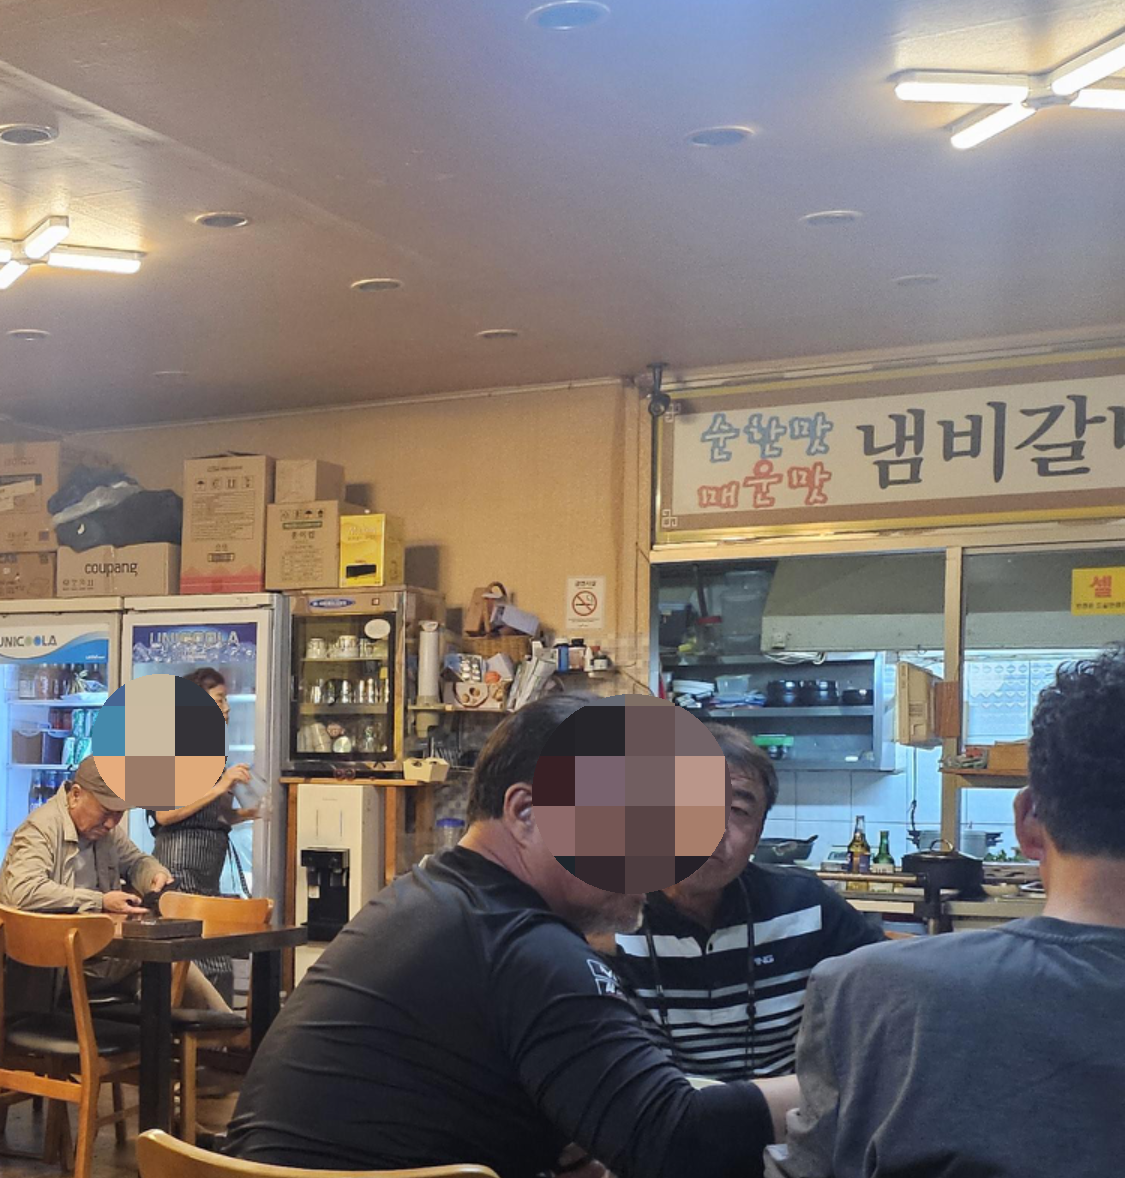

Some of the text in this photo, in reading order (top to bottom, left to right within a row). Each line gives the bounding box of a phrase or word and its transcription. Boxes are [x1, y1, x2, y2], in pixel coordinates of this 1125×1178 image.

[700, 411, 834, 463] 순한맛
[856, 394, 1125, 489] 냄비갈
[697, 459, 832, 508] 매운맛
[85, 562, 138, 576] coupang
[1089, 575, 1112, 598] 셀
